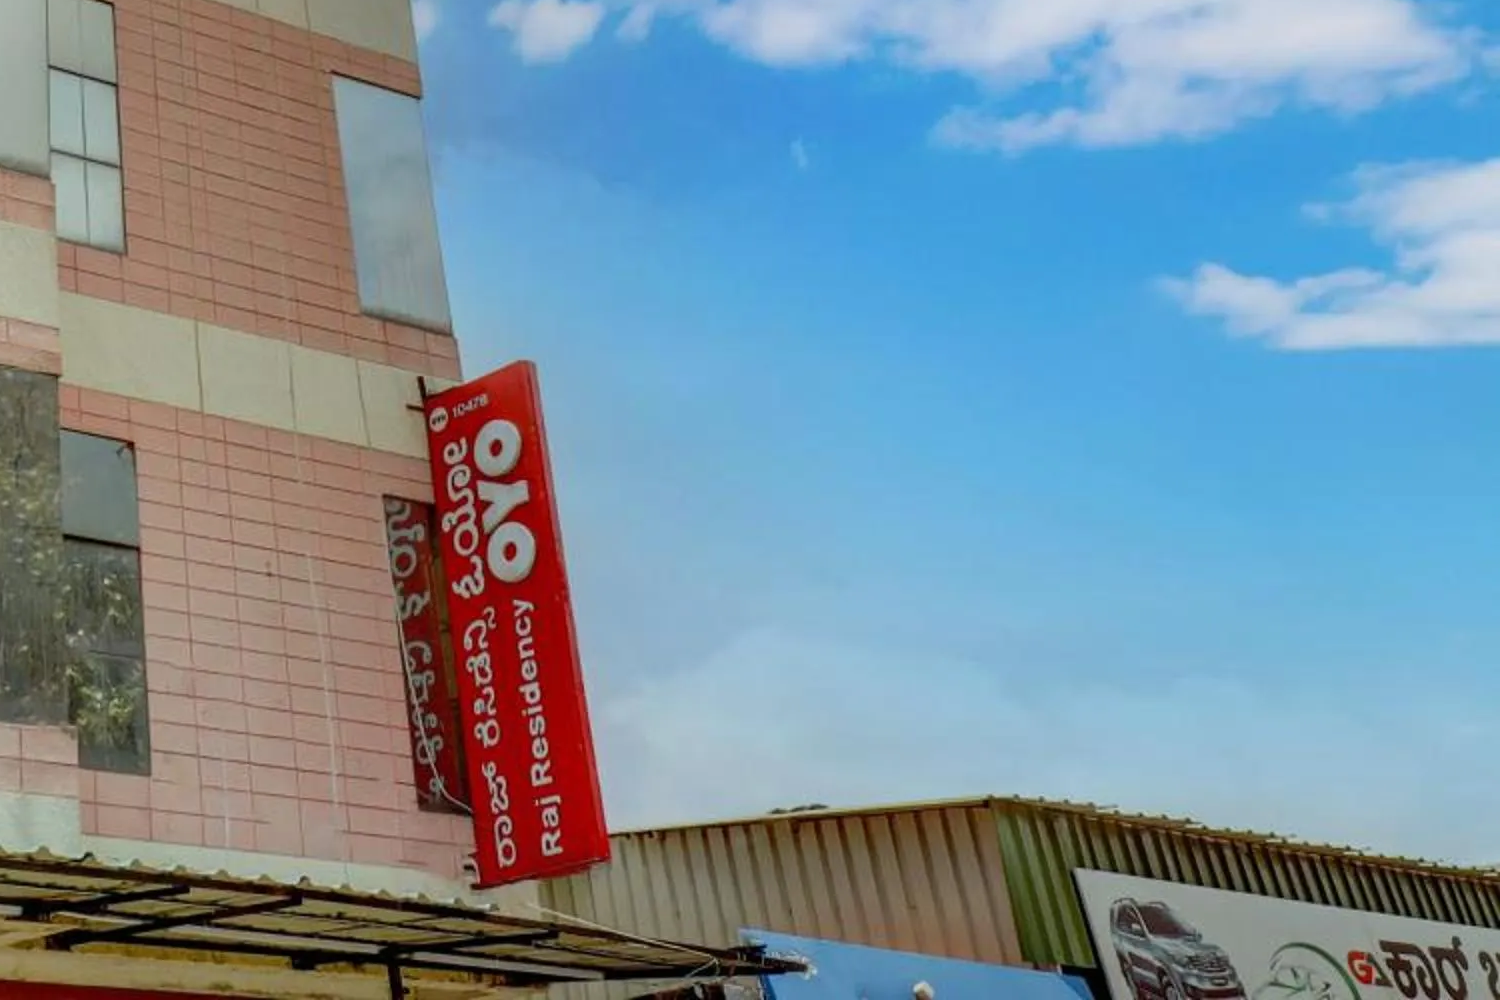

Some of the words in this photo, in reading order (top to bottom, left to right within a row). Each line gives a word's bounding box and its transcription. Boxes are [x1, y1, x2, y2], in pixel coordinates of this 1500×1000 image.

[473, 419, 536, 583] OYO
[512, 599, 553, 787] Residency
[535, 795, 564, 857] Raj
